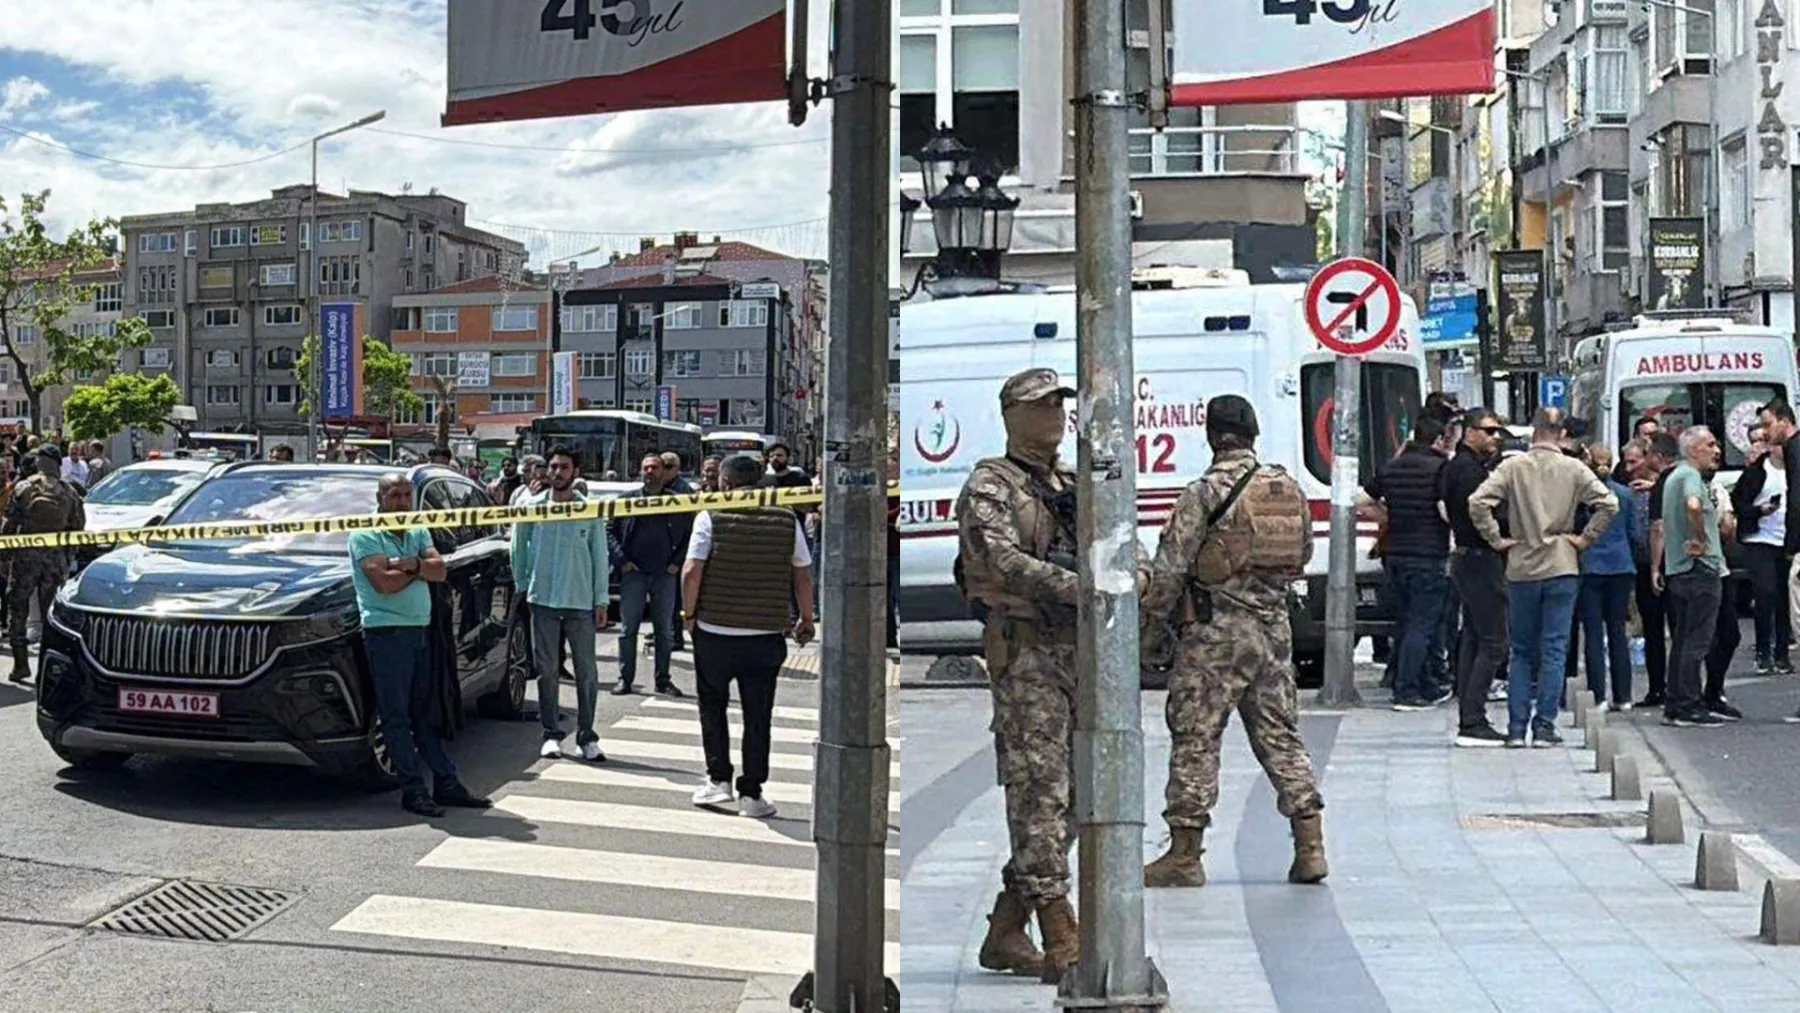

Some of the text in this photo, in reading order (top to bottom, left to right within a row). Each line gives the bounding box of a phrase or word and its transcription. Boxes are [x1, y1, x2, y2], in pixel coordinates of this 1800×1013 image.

[541, 0, 650, 40] 45
[1637, 352, 1763, 375] AMBULANS
[1548, 381, 1564, 406] P
[126, 693, 211, 712] 59 AA 102
